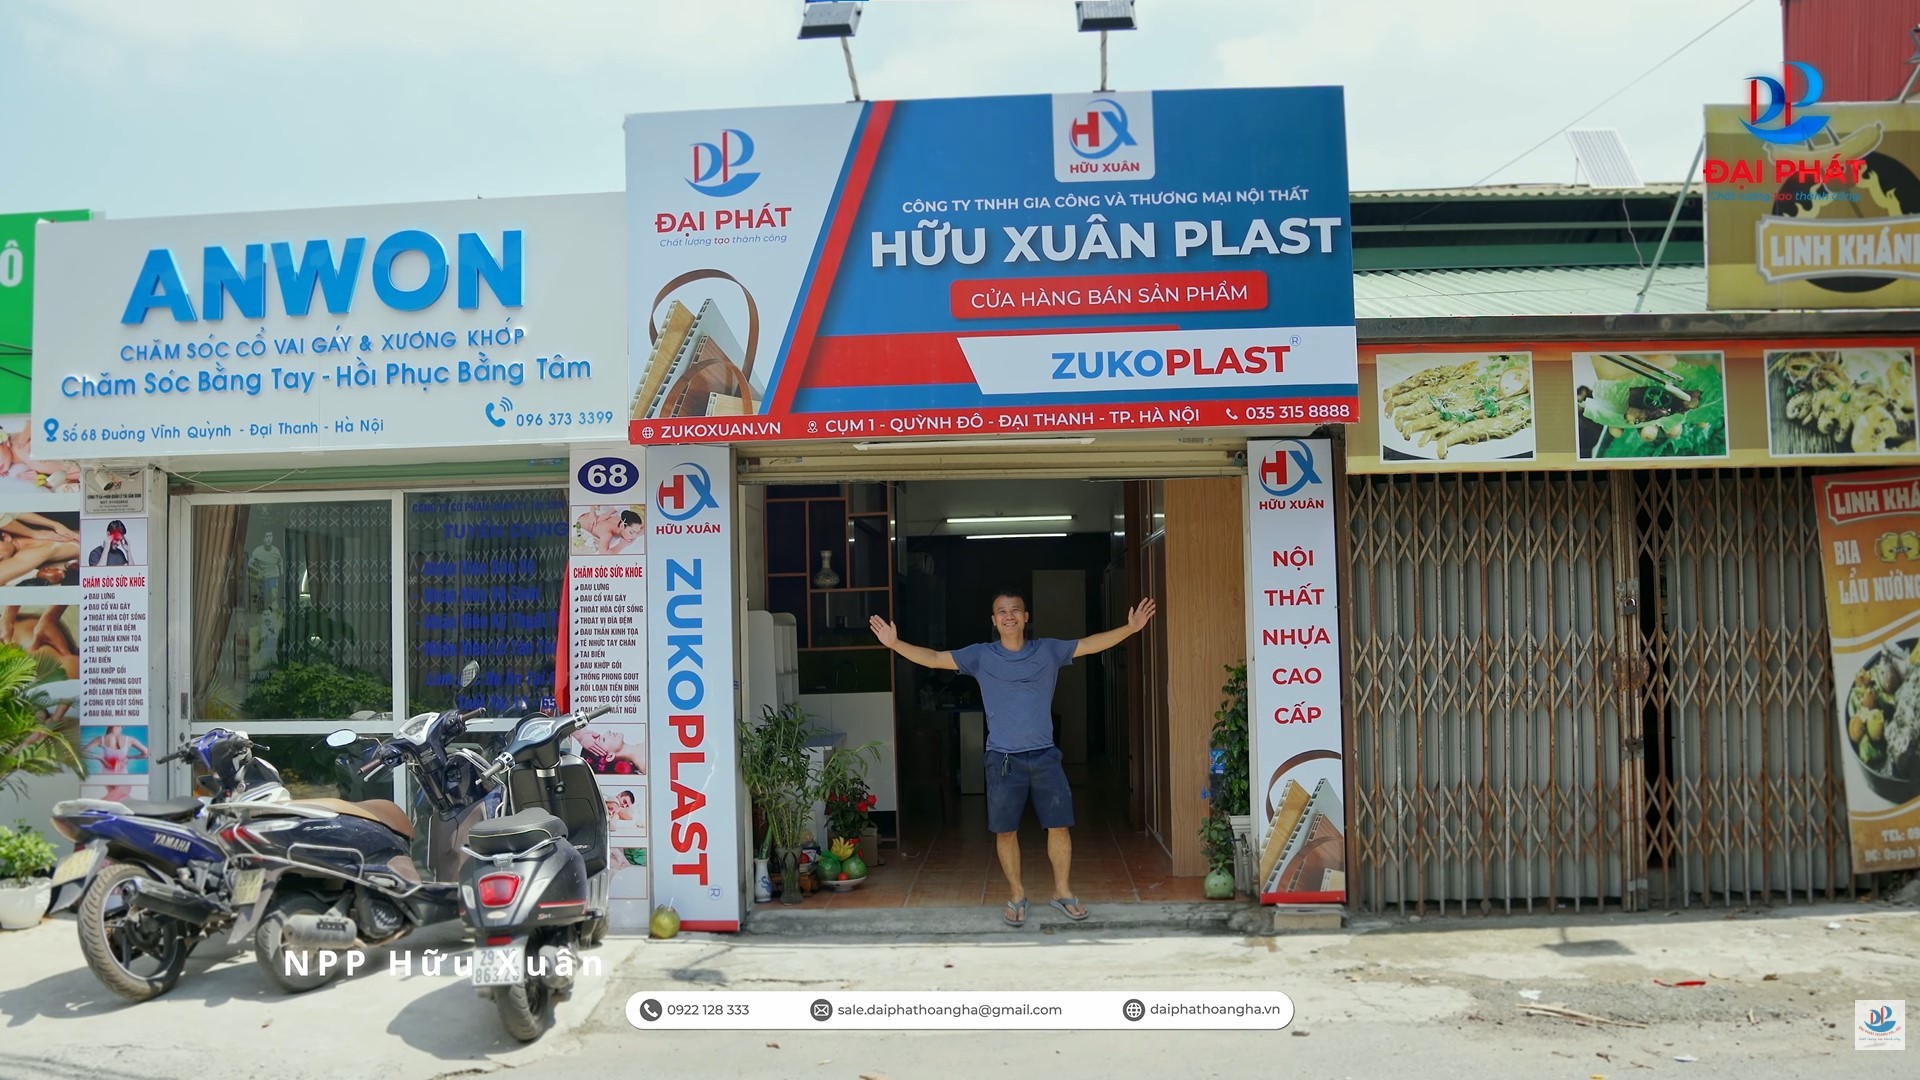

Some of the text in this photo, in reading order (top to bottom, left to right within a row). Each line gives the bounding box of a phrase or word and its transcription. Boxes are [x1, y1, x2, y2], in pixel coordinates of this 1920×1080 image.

[1069, 160, 1140, 174] HỮU XUÂN
[902, 185, 1309, 213] CÔNG TY TNHH GIA CÔNG VÀ THƯƠNG MẠI NỘI THẤT
[655, 202, 792, 237] ĐẠI PHÁT
[659, 237, 683, 247] Chất
[714, 237, 730, 245] tạo
[732, 234, 761, 244] thành
[763, 234, 788, 245] công
[871, 213, 1342, 268] HỮU XUÂN PLAST
[1769, 233, 1832, 267] LINH
[121, 229, 524, 325] ANWON
[971, 280, 1248, 310] CỬA HÀNG BÁN SẢN PHẨM
[120, 317, 525, 361] CHĂM SÓC CỔ VAI GÁY & XƯƠNG KHỚP
[61, 371, 136, 398] Chăm
[144, 368, 191, 394] Sóc
[198, 361, 262, 396] Bằng
[271, 368, 315, 394] Tay
[336, 356, 377, 388] Hồi
[386, 362, 450, 392] Phục
[458, 351, 525, 387] Bằng
[536, 353, 591, 381] Tâm
[1051, 345, 1291, 380] ZUKOPLAST
[516, 410, 613, 427] 096 373 3399
[825, 418, 865, 436] CỤM
[868, 418, 875, 432] 1
[890, 412, 952, 431] QUỲNH
[956, 412, 984, 429] ĐÔ
[998, 414, 1029, 431] ĐẠI
[1033, 411, 1094, 427] THANH
[1109, 410, 1135, 424] TP.
[1139, 406, 1165, 423] HÀ
[1169, 405, 1199, 424] NỘI
[1245, 404, 1350, 420] 035 315 8888
[62, 423, 78, 442] Số
[80, 428, 97, 441] 68
[187, 420, 231, 440] Quỳnh
[249, 423, 272, 439] Đại
[278, 421, 318, 435] Thanh
[335, 416, 354, 433] Hà
[360, 418, 384, 435] Nội
[661, 421, 782, 439] ZUKOXUAN.VN
[587, 464, 629, 487] 68
[1259, 497, 1325, 510] HỮU XUÂN
[1833, 489, 1880, 515] LINH
[655, 521, 721, 535] HỮU XUÂN
[1272, 546, 1314, 572] NỘI
[1833, 540, 1861, 566] BIA
[82, 572, 146, 588] CHĂM SÓC SỨC KHỎE
[573, 562, 643, 579] CHĂM SÓC SỨC KHỎE
[580, 583, 610, 591] ĐAU LƯNG
[580, 594, 592, 602] ĐAU
[604, 594, 613, 602] VAI
[1264, 583, 1325, 607] THẤT
[1839, 567, 1869, 605] LẨU
[580, 604, 598, 613] THOÁT
[614, 604, 625, 614] CỘT
[627, 603, 644, 613] SỐNG
[1262, 625, 1331, 650] NHỰA
[580, 650, 589, 658] TAI
[580, 661, 592, 669] ĐAU
[1271, 667, 1322, 685] CAO
[580, 695, 597, 703] CONG
[611, 694, 622, 704] CỘT
[624, 693, 641, 703] SỐNG
[665, 558, 709, 886] ZUKOPLAST
[1273, 701, 1322, 725] CẤP
[152, 833, 192, 854] YAMAHA
